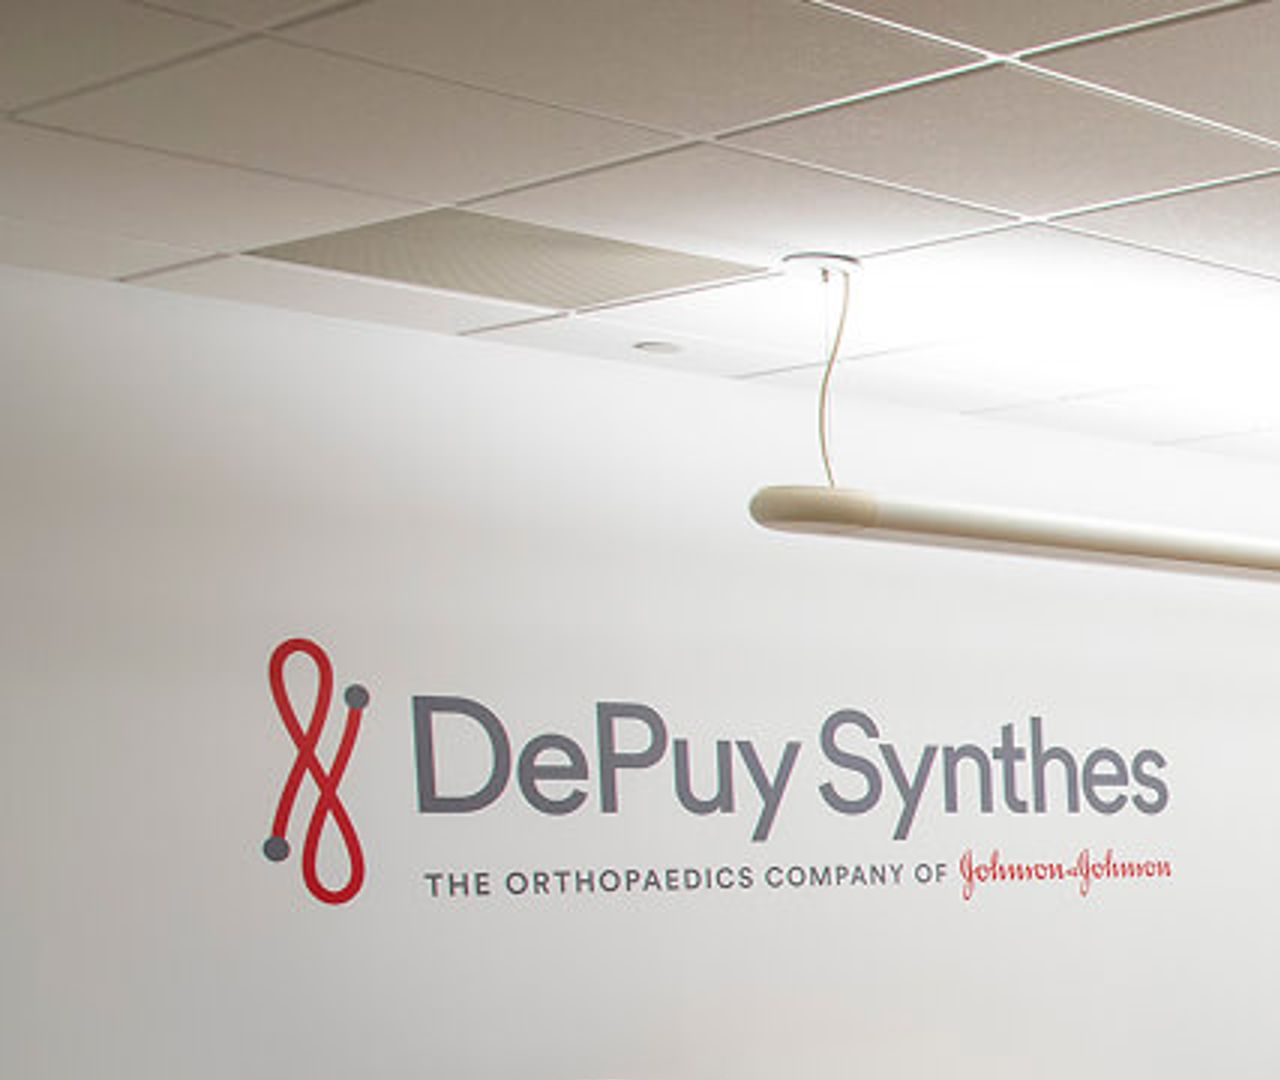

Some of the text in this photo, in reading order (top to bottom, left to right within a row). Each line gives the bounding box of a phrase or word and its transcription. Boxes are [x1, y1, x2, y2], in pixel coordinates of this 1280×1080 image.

[411, 695, 1169, 843] DePuy Synthes
[423, 871, 491, 898] THE
[505, 866, 754, 897] ORTHOPAEDICS
[764, 864, 904, 890] COMPANY
[914, 863, 947, 884] OF
